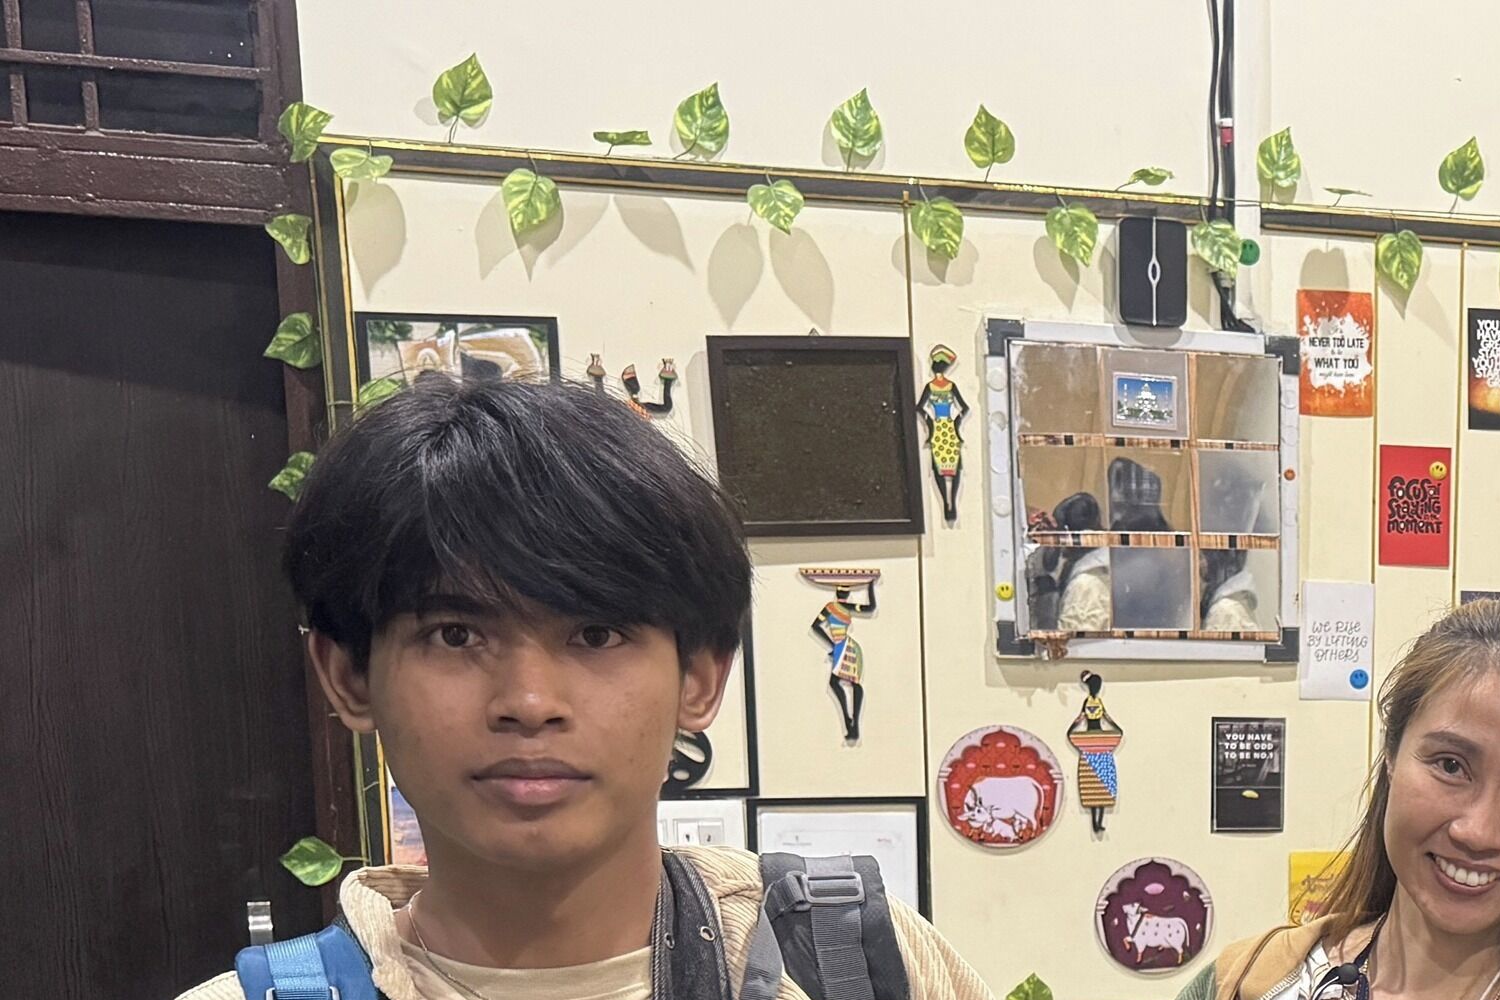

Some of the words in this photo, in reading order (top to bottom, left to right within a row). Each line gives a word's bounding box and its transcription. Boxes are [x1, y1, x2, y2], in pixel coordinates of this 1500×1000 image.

[1477, 319, 1499, 331] YOU
[1309, 337, 1330, 347] NEVER
[1333, 336, 1345, 348] TOO
[1347, 338, 1364, 348] LATE
[1314, 357, 1340, 368] WHAT
[1343, 358, 1359, 369] YOU
[1472, 357, 1495, 368] YOU
[1225, 733, 1245, 741] YOU
[1247, 733, 1272, 741] HAVE
[1224, 742, 1237, 750] TO
[1239, 742, 1251, 750] BE
[1253, 742, 1274, 750] ODD
[1224, 751, 1237, 759] TO
[1239, 751, 1251, 759] BE
